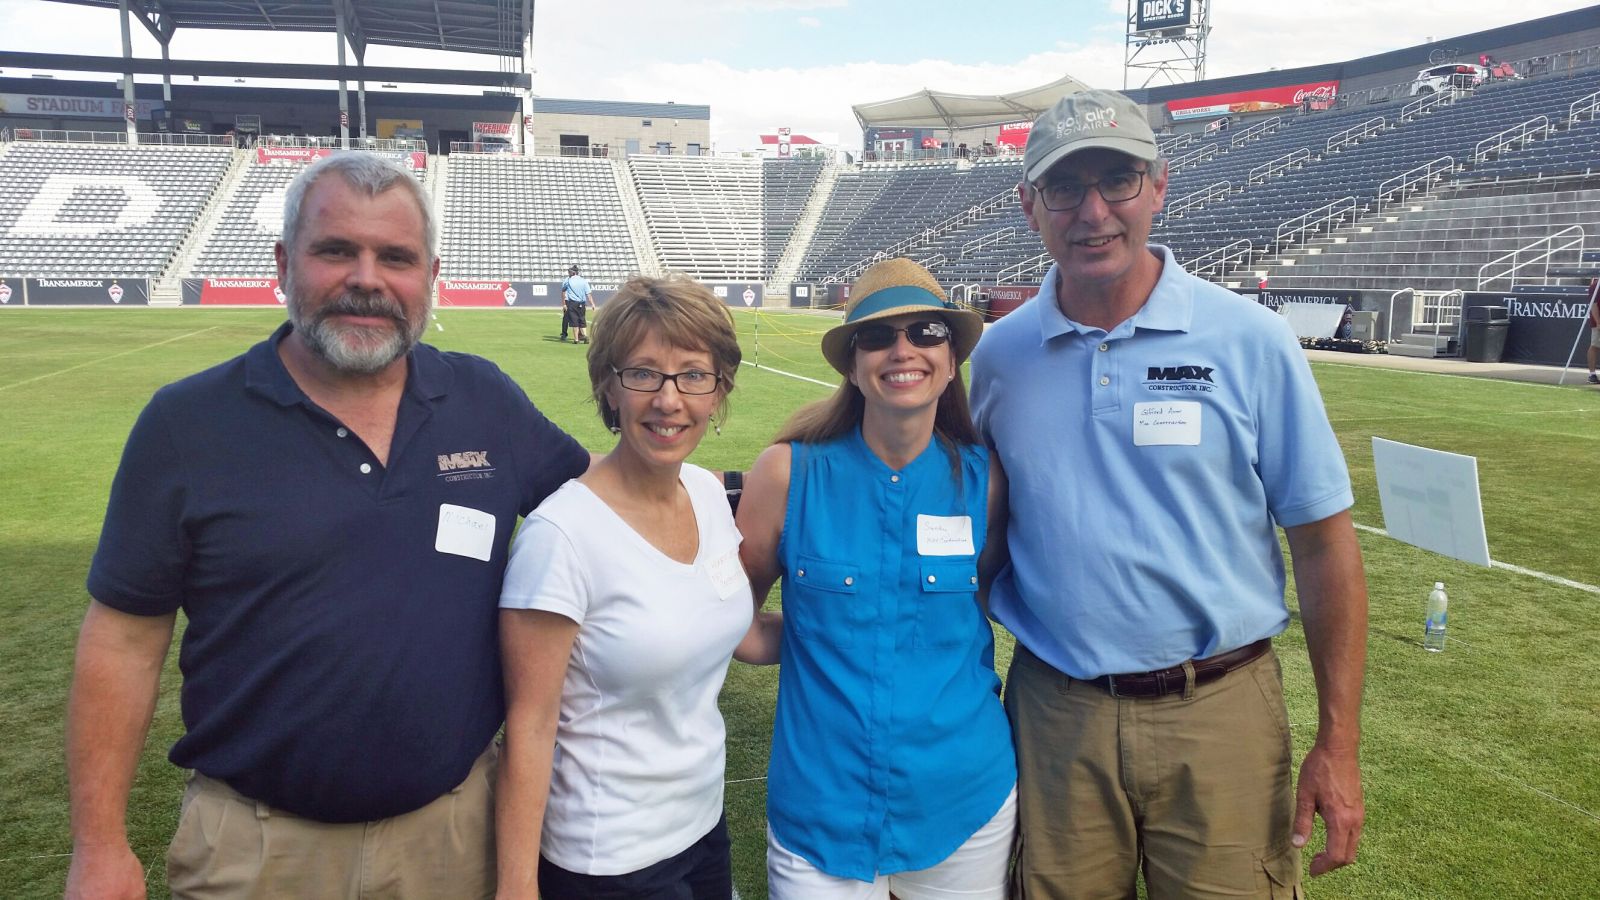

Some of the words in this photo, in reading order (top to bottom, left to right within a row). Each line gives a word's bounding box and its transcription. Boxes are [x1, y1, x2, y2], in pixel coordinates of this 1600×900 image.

[1143, 0, 1185, 17] DICK'S
[27, 97, 104, 113] STADIUM
[36, 278, 103, 288] TRANSAMERICA
[207, 278, 271, 288] TRANSAMERICA
[444, 282, 503, 291] TRANSAMERICA
[988, 288, 1021, 300] TRANSAMERICA
[1503, 297, 1590, 319] TRANSAME
[1147, 365, 1215, 383] MAX
